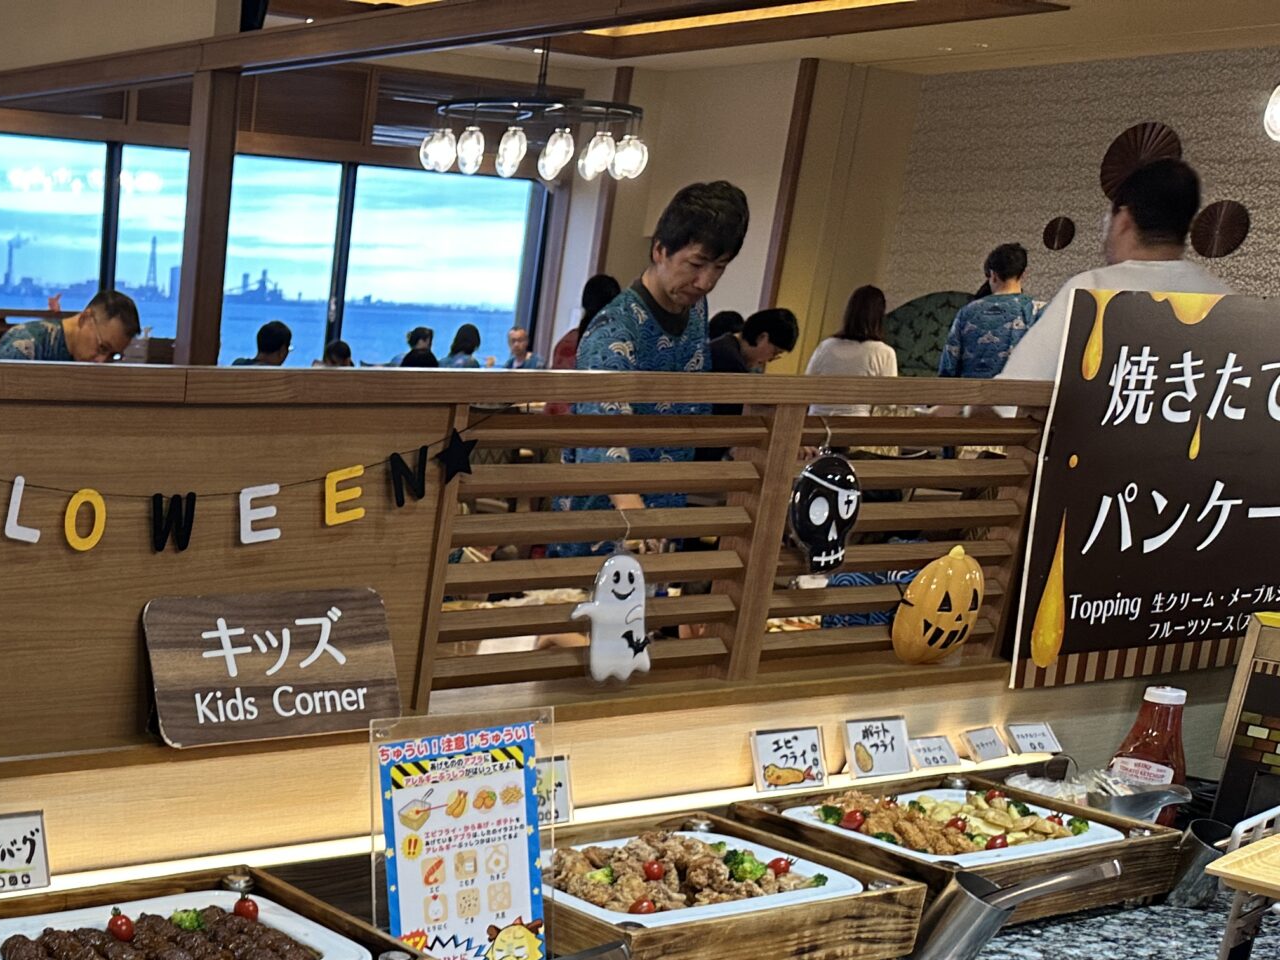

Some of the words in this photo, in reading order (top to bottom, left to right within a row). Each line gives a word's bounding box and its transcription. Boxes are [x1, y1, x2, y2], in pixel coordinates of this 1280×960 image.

[1081, 481, 1280, 555] パンケー
[1069, 593, 1142, 625] Topping
[1151, 585, 1280, 613] 生クリーム・メープル
[201, 606, 347, 678] キッズ
[194, 686, 258, 725] Kids
[273, 684, 368, 718] Corner
[772, 735, 799, 752] エビ
[862, 723, 890, 741] ポテト
[870, 737, 896, 755] フライ
[780, 751, 807, 766] フライ
